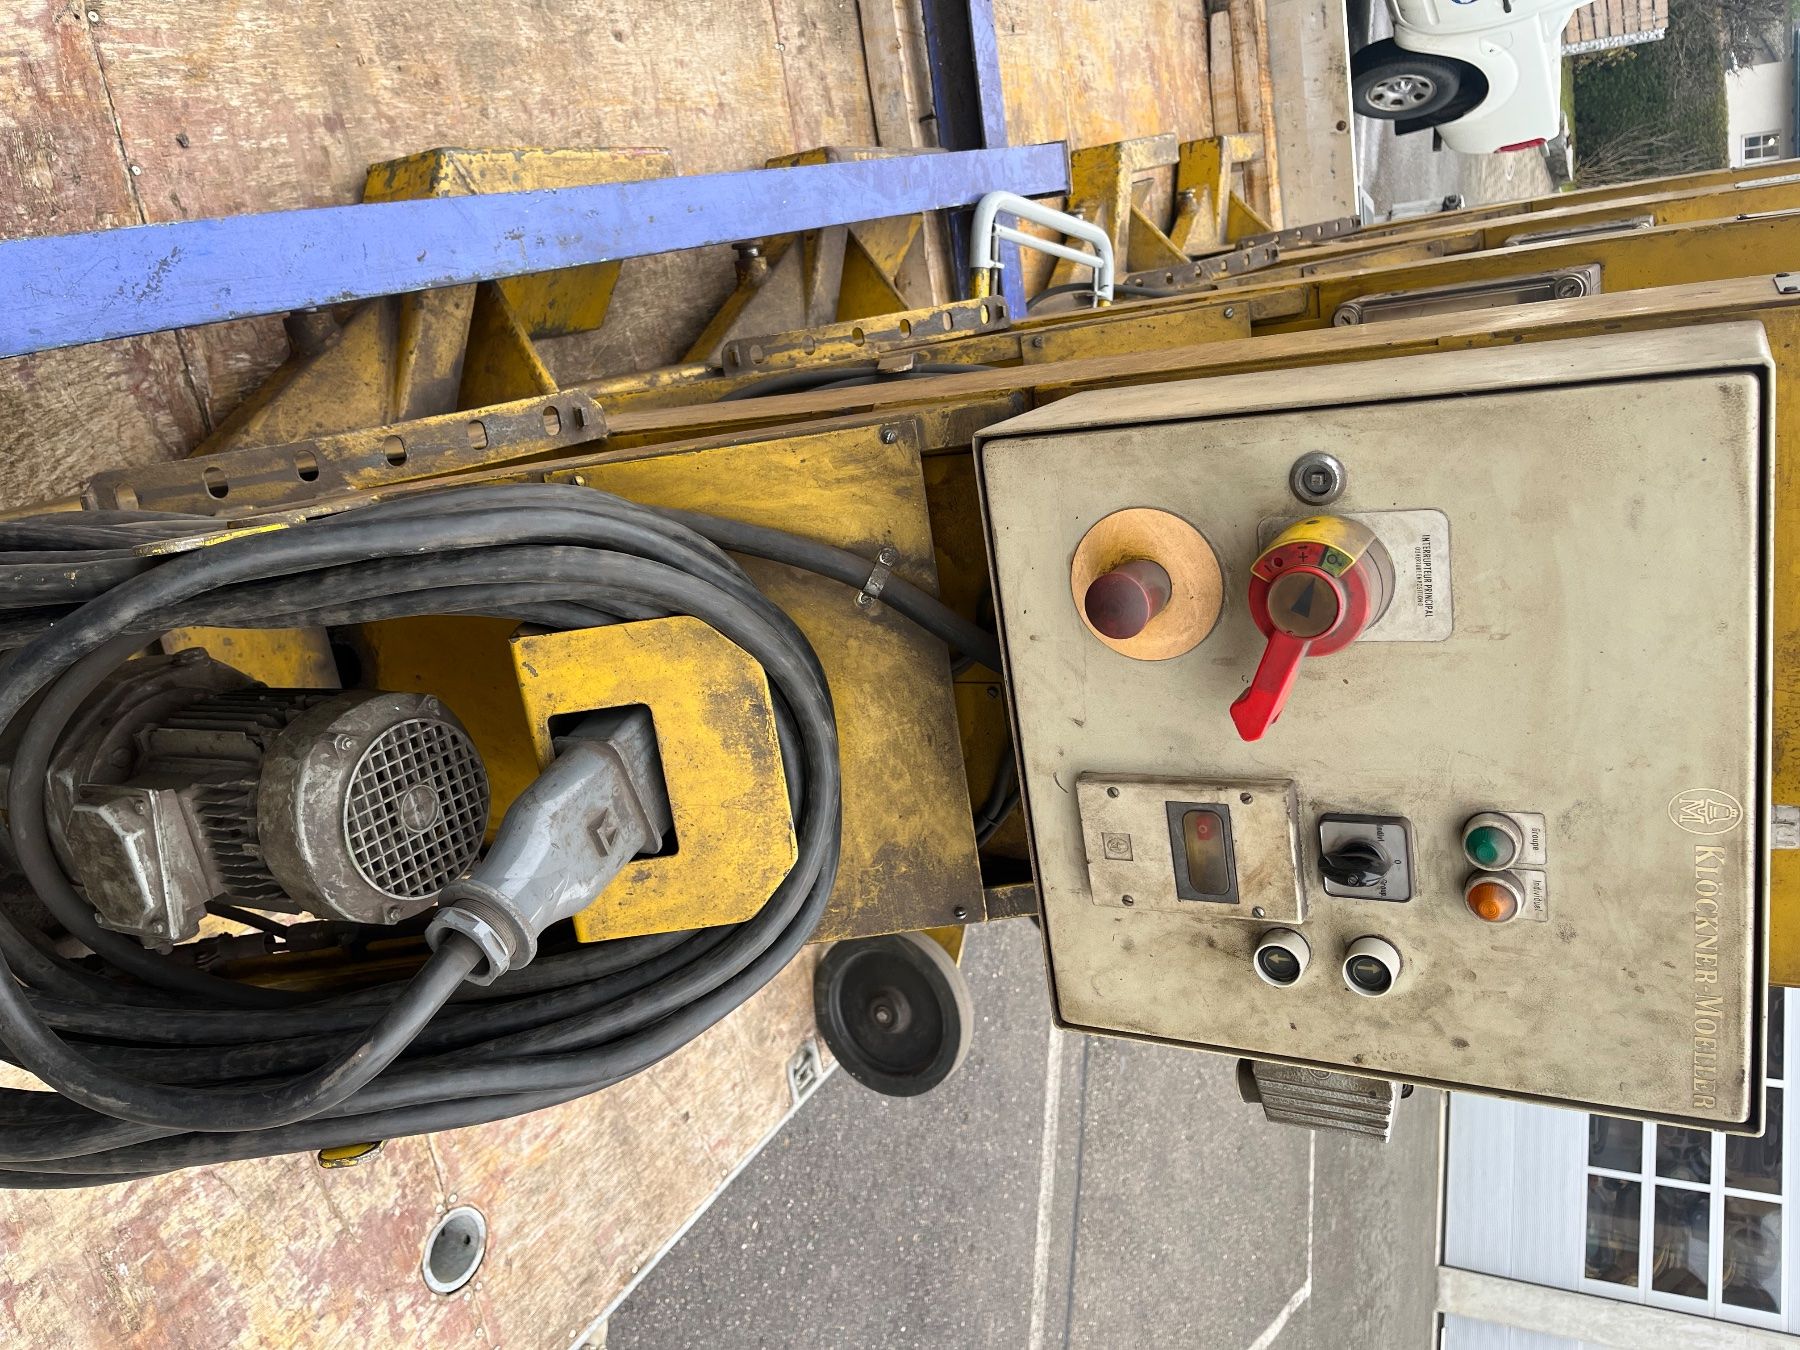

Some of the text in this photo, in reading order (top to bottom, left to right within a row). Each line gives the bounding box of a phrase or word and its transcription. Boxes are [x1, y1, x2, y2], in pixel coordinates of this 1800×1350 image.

[1421, 534, 1434, 618] INTERRUPTEUR PRINCIPAL
[1530, 827, 1541, 851] Groupe
[1532, 880, 1543, 912] Individuel
